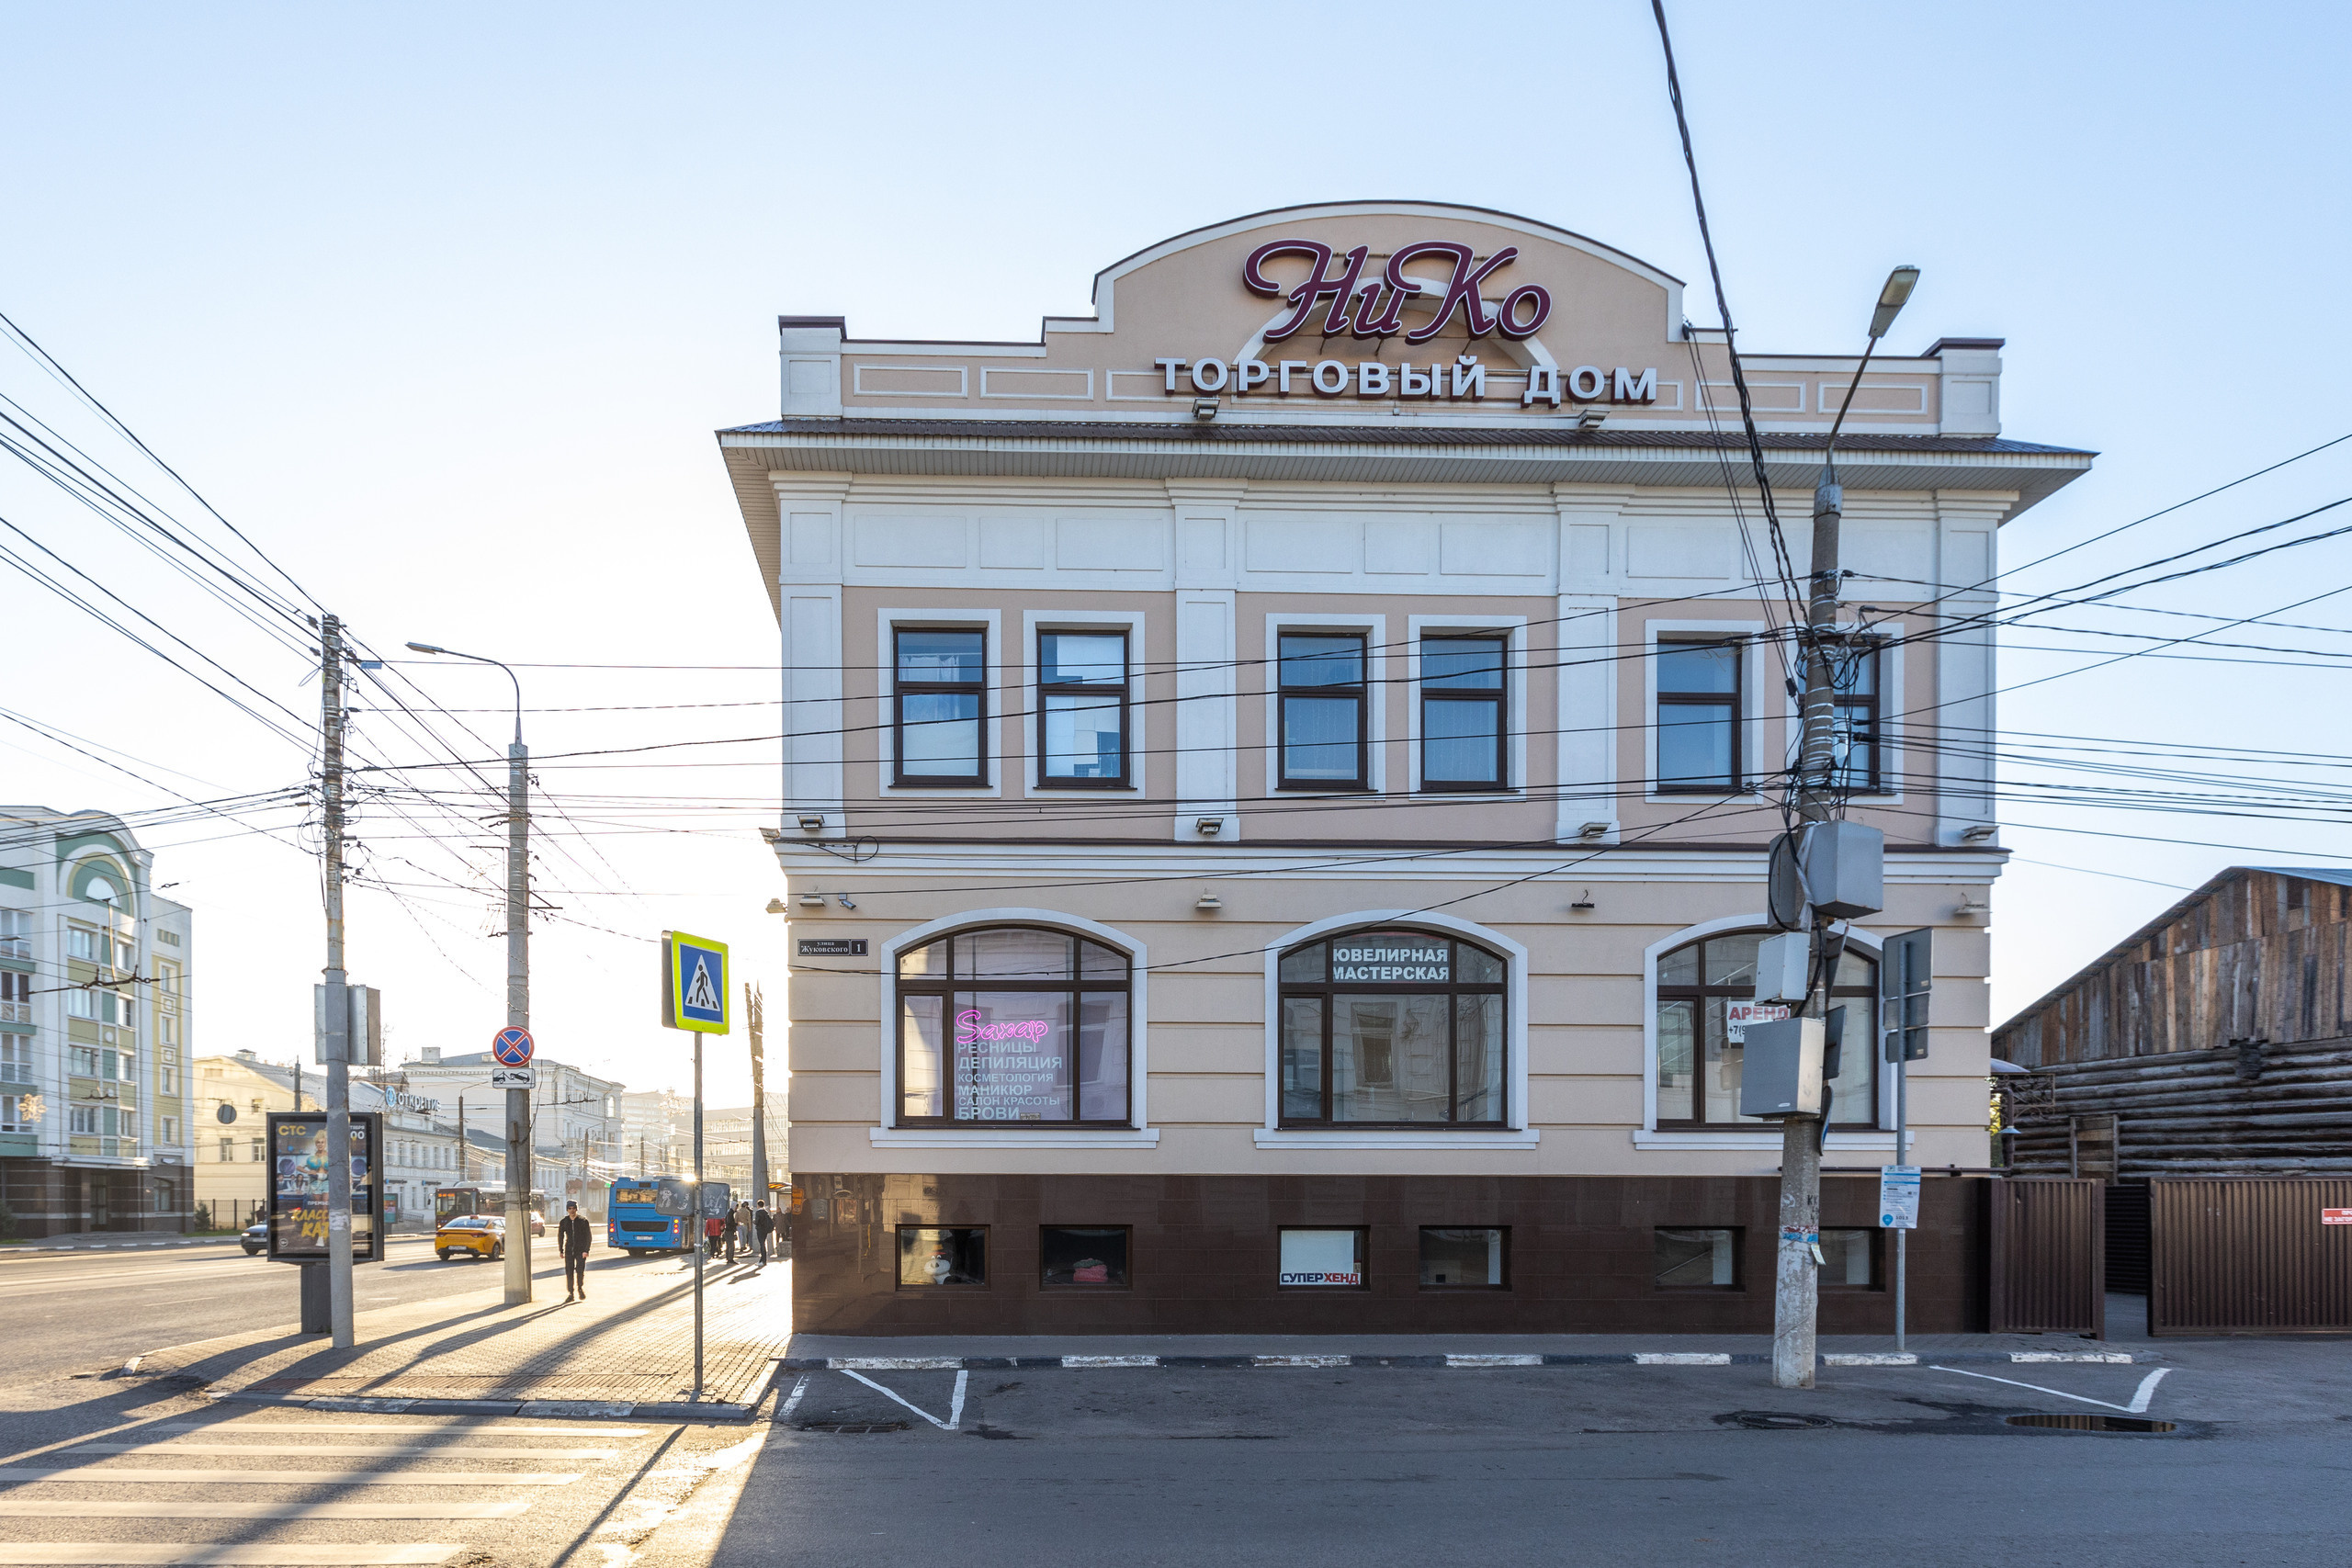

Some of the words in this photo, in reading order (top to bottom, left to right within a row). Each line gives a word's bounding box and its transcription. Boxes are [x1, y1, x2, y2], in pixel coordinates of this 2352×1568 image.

[1243, 239, 1553, 345] НиКо
[1155, 355, 1486, 402] ТОРГОВЫЙ
[1521, 365, 1657, 409] ДОМ
[801, 945, 848, 954] Жуковского
[856, 943, 861, 953] 1
[1333, 948, 1448, 962] ЮВЕЛИРНАЯ
[1333, 966, 1449, 980] МАСТЕРСКАЯ
[957, 1042, 1036, 1055] РЕСНИЦЫ
[958, 1056, 1062, 1071] ДЕПИЛЯЦИЯ
[958, 1073, 1054, 1083] КОСМЕТОЛОГИЯ
[958, 1085, 1033, 1096] МАНИКЮР
[958, 1097, 1000, 1106] САЛОН
[1004, 1096, 1060, 1106] КРАСОТЫ
[958, 1107, 1020, 1120] БРОВИ
[278, 1125, 306, 1136] СТС
[1281, 1273, 1359, 1285] СУПЕРХЕНД
